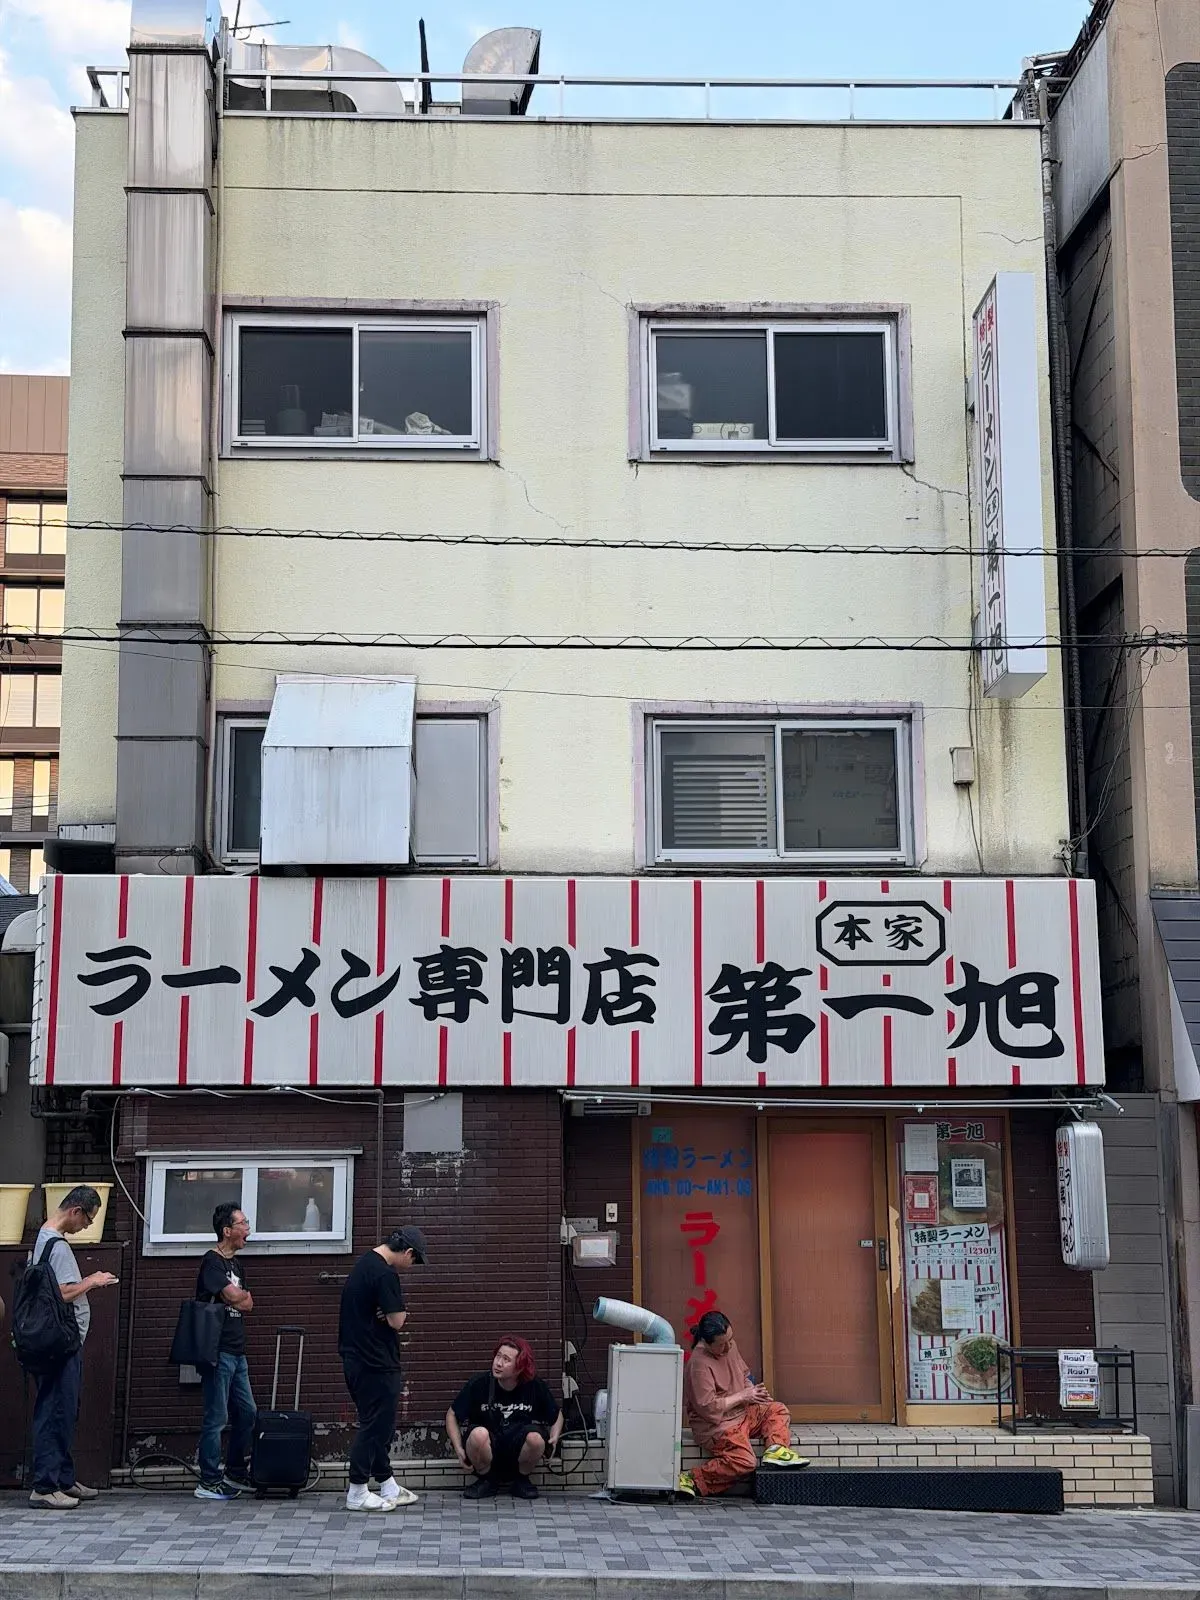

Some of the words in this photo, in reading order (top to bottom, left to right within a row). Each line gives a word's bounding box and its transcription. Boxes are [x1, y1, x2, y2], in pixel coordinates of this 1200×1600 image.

[982, 342, 997, 488] ラーメン
[833, 913, 923, 951] 本家
[77, 944, 660, 1026] ラーメン専門店
[704, 961, 1065, 1064] 第一旭
[914, 1226, 985, 1243] 特製ラーメン
